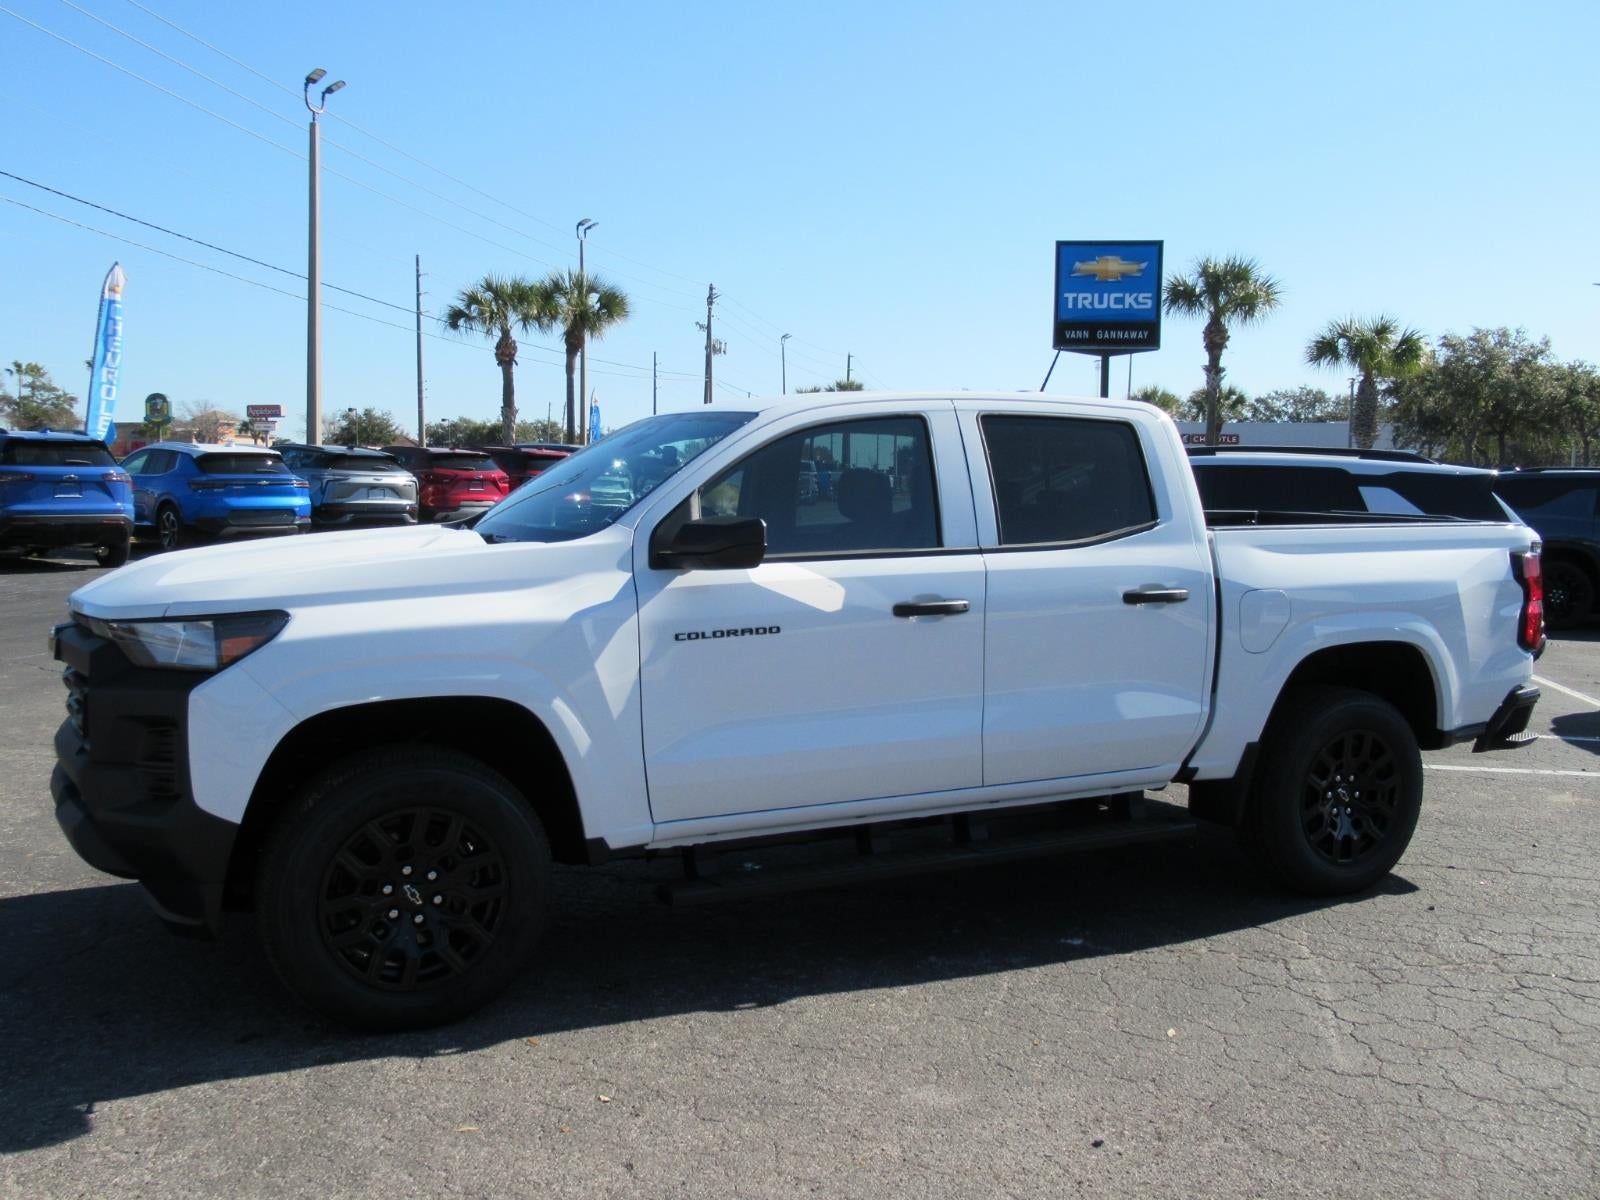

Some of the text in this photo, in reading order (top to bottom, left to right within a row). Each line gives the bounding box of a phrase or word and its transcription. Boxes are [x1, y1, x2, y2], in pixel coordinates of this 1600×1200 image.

[1064, 293, 1152, 309] TRUCKS
[1065, 330, 1149, 339] VANN GANNAWAY
[1193, 435, 1237, 443] CHTLE
[675, 626, 781, 641] COLORADO
